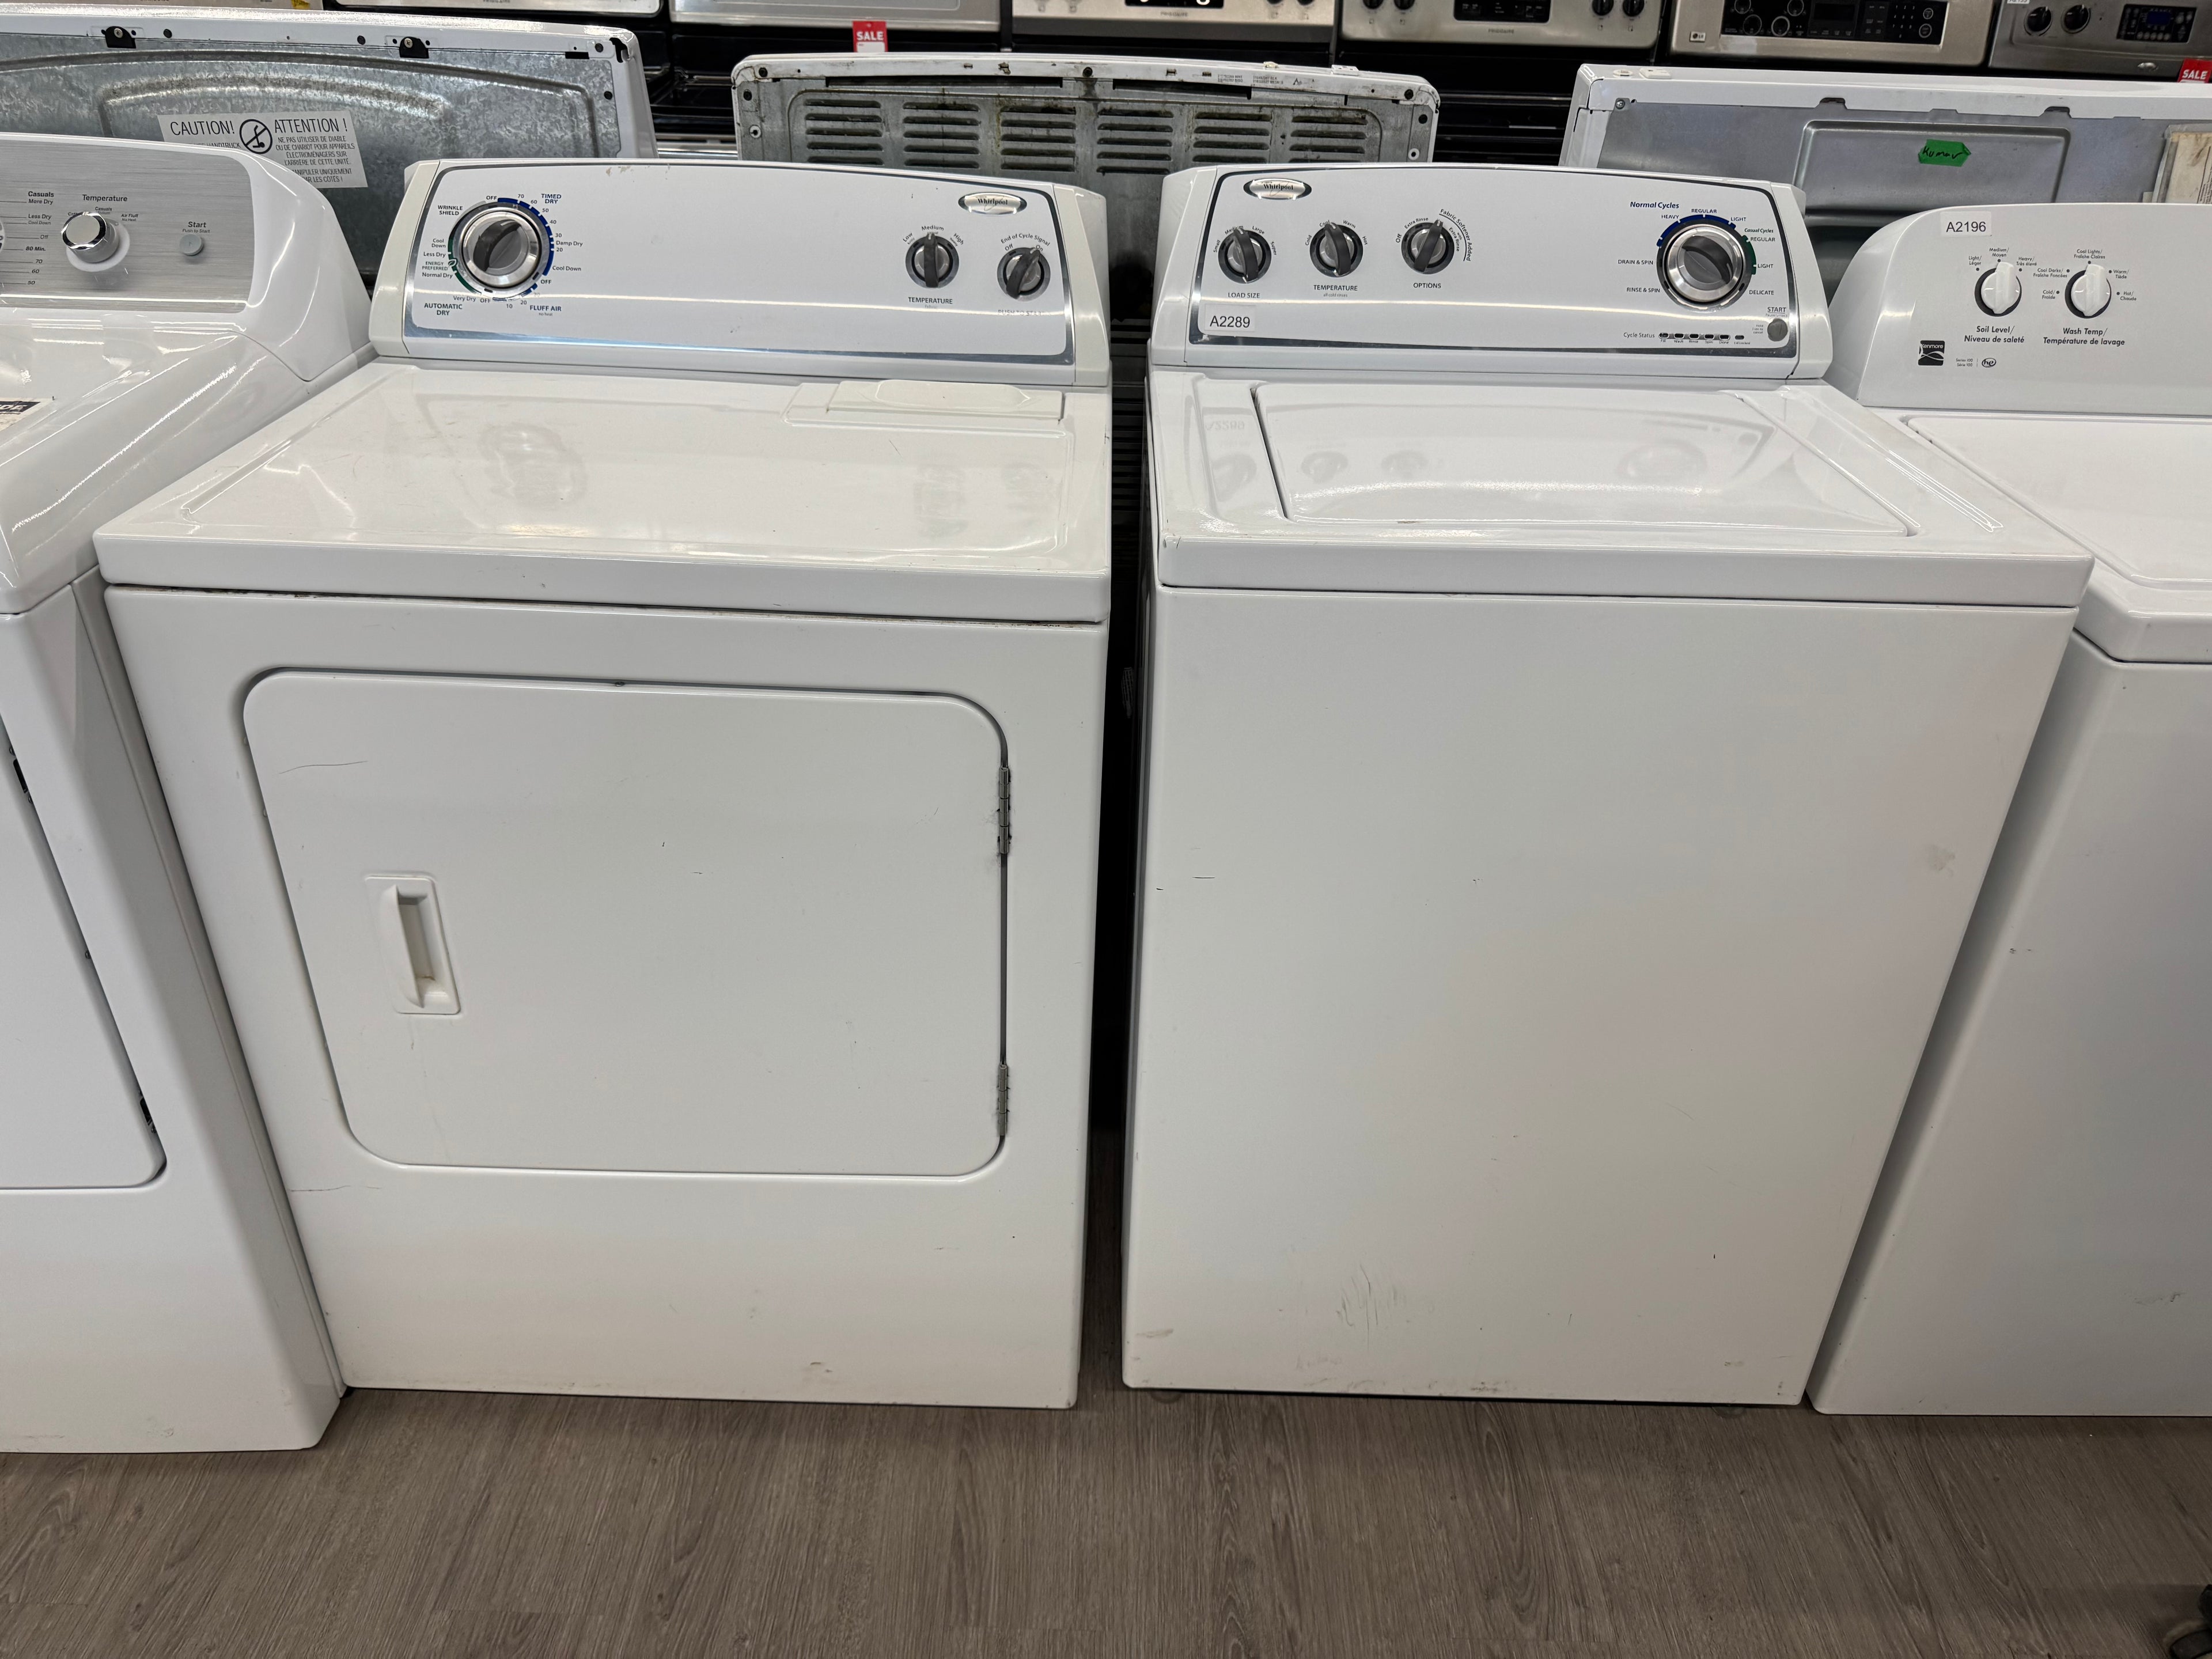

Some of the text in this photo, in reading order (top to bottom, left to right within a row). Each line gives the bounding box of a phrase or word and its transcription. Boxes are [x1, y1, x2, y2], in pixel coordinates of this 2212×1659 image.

[857, 31, 884, 40] SALE
[2181, 69, 2209, 80] SALE
[171, 120, 235, 135] CAUTION!
[274, 118, 339, 133] ATTENTION
[82, 194, 128, 202] Temperature
[1343, 219, 1356, 229] Warm
[1404, 220, 1416, 229] Extra
[1440, 208, 1457, 220] Fabric
[1456, 218, 1471, 241] Softener
[1946, 221, 1986, 233] A2196
[1252, 225, 1265, 235] Large
[1449, 227, 1457, 239] Extra
[903, 232, 913, 243] Low
[953, 233, 964, 245] High
[1001, 235, 1012, 244] End
[1034, 235, 1051, 247] Signal
[1005, 243, 1014, 251] Off
[908, 297, 953, 305] TEMPERATURE
[1210, 316, 1251, 328] A2289
[1991, 325, 2015, 335] Level/
[2084, 327, 2108, 337] Temp/
[1964, 335, 1990, 343] Niveau
[2003, 335, 2025, 343] saleté
[2043, 336, 2088, 346] Température
[2101, 338, 2125, 347] lavage
